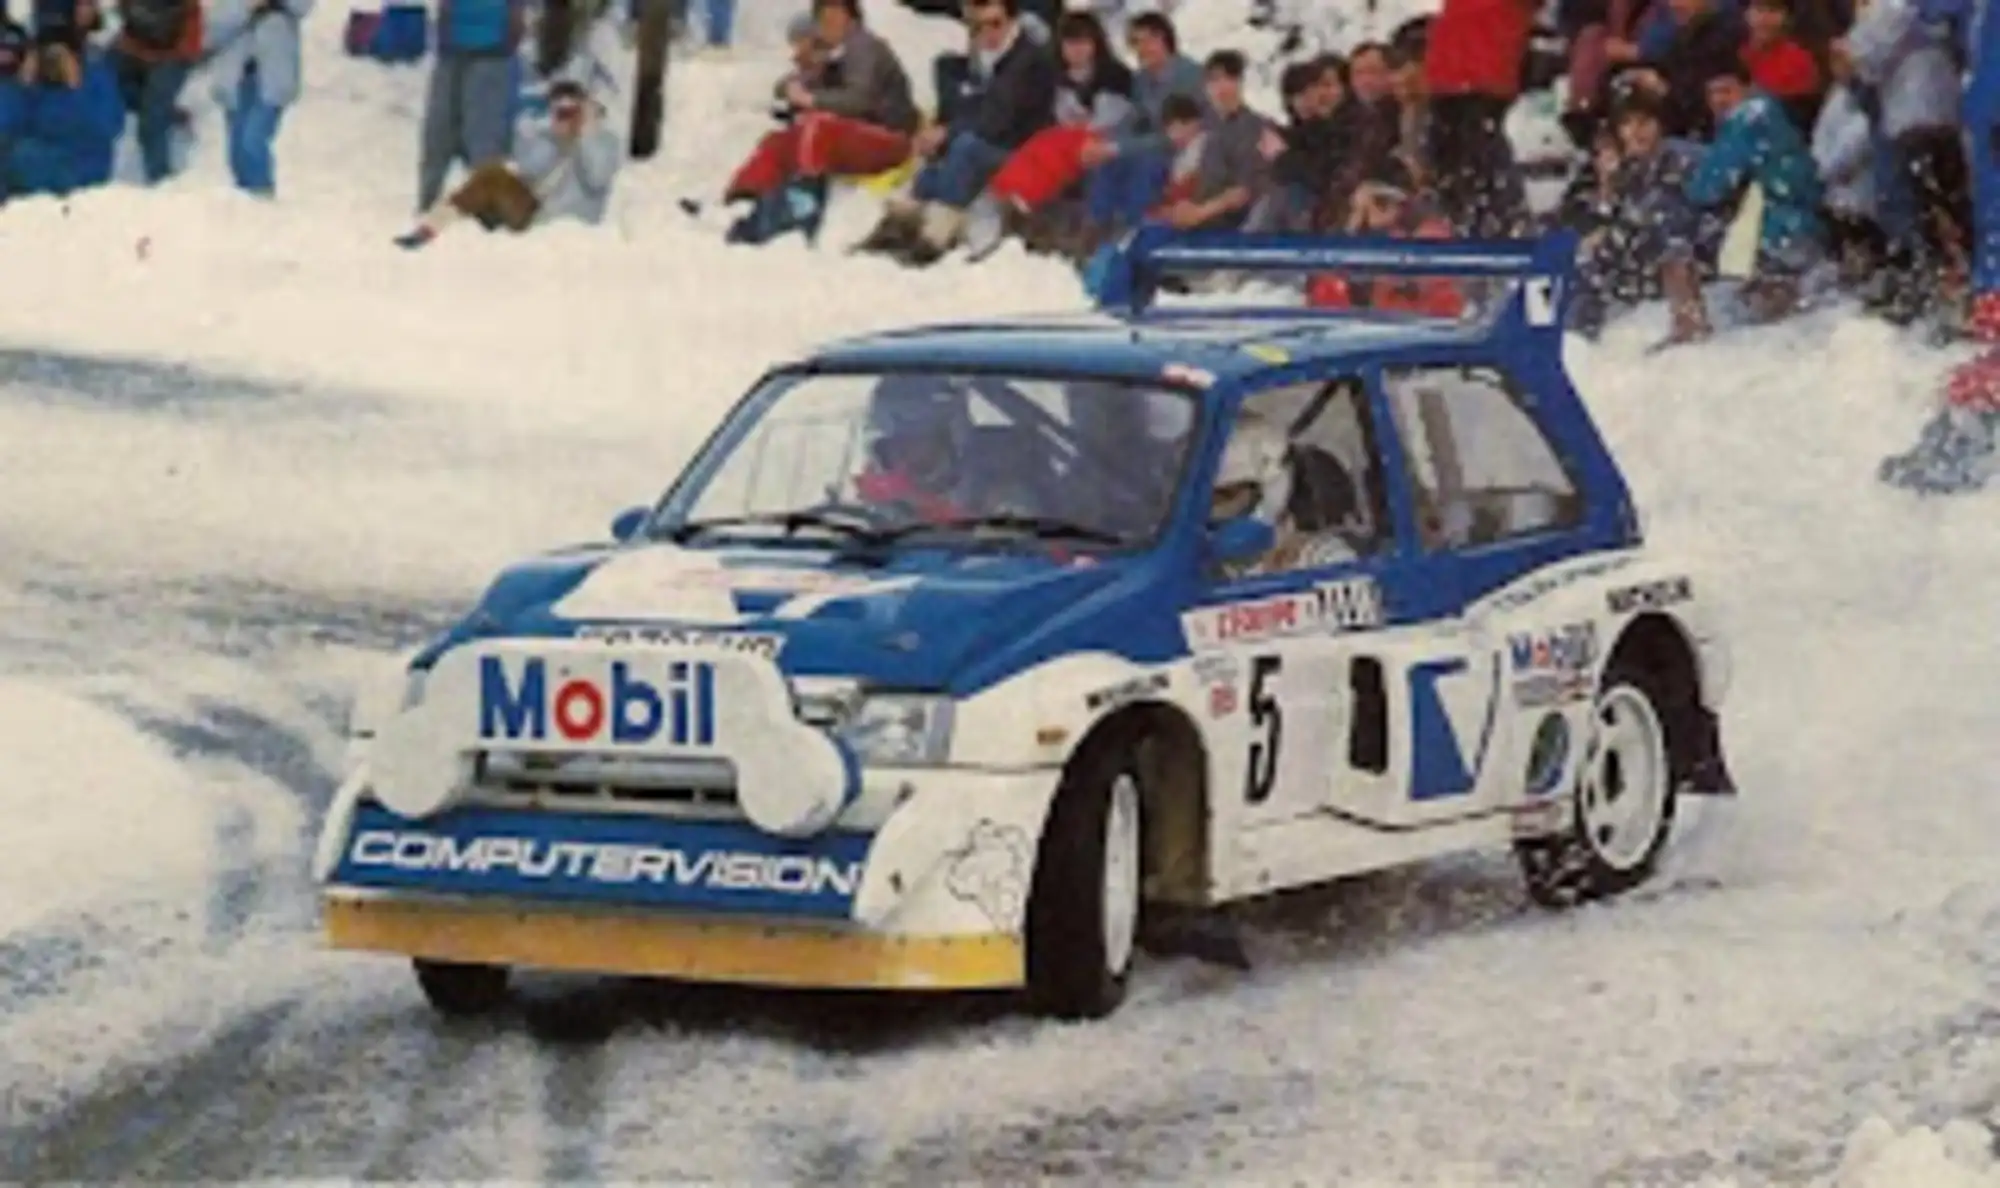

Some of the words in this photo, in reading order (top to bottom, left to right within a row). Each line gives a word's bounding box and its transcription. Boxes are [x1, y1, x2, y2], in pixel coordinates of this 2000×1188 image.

[479, 655, 714, 745] Mobil
[1246, 655, 1281, 804] 5
[351, 832, 859, 895] COMPUTERVISION
